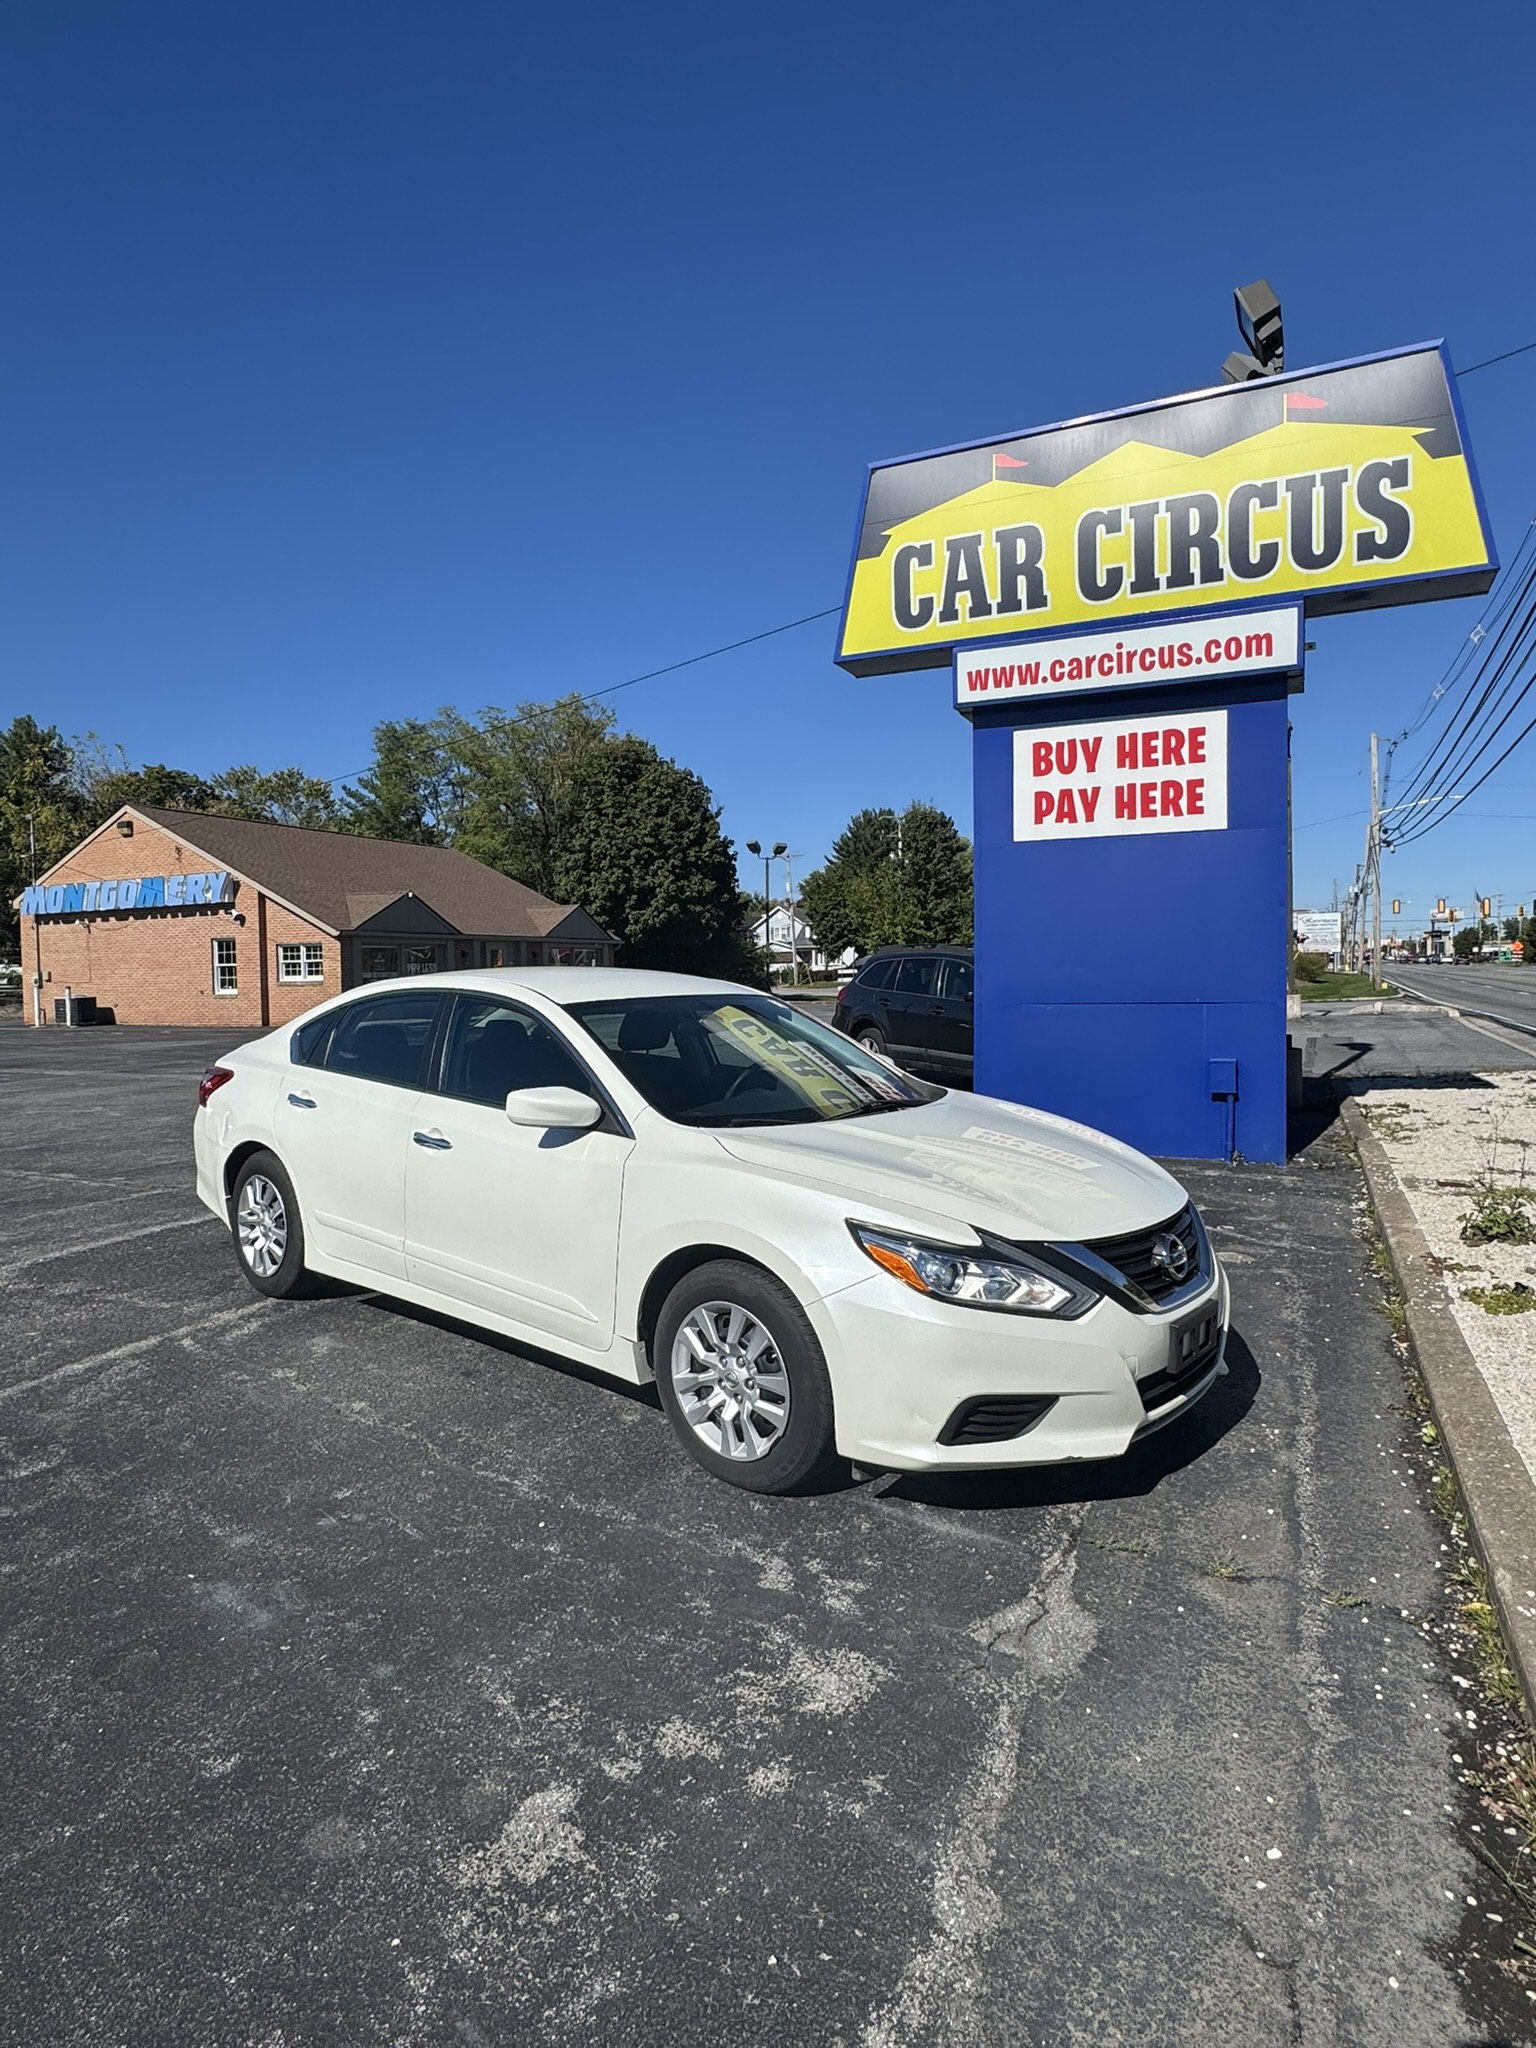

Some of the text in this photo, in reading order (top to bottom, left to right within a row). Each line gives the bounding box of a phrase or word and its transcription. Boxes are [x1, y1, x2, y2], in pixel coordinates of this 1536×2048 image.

[892, 455, 1412, 632] CAR CIRCUS
[967, 631, 1274, 692] www.carcircus.com
[1032, 726, 1207, 777] BUY HERE
[1034, 778, 1206, 825] PAY HERE
[20, 871, 228, 915] MONTGOMERY
